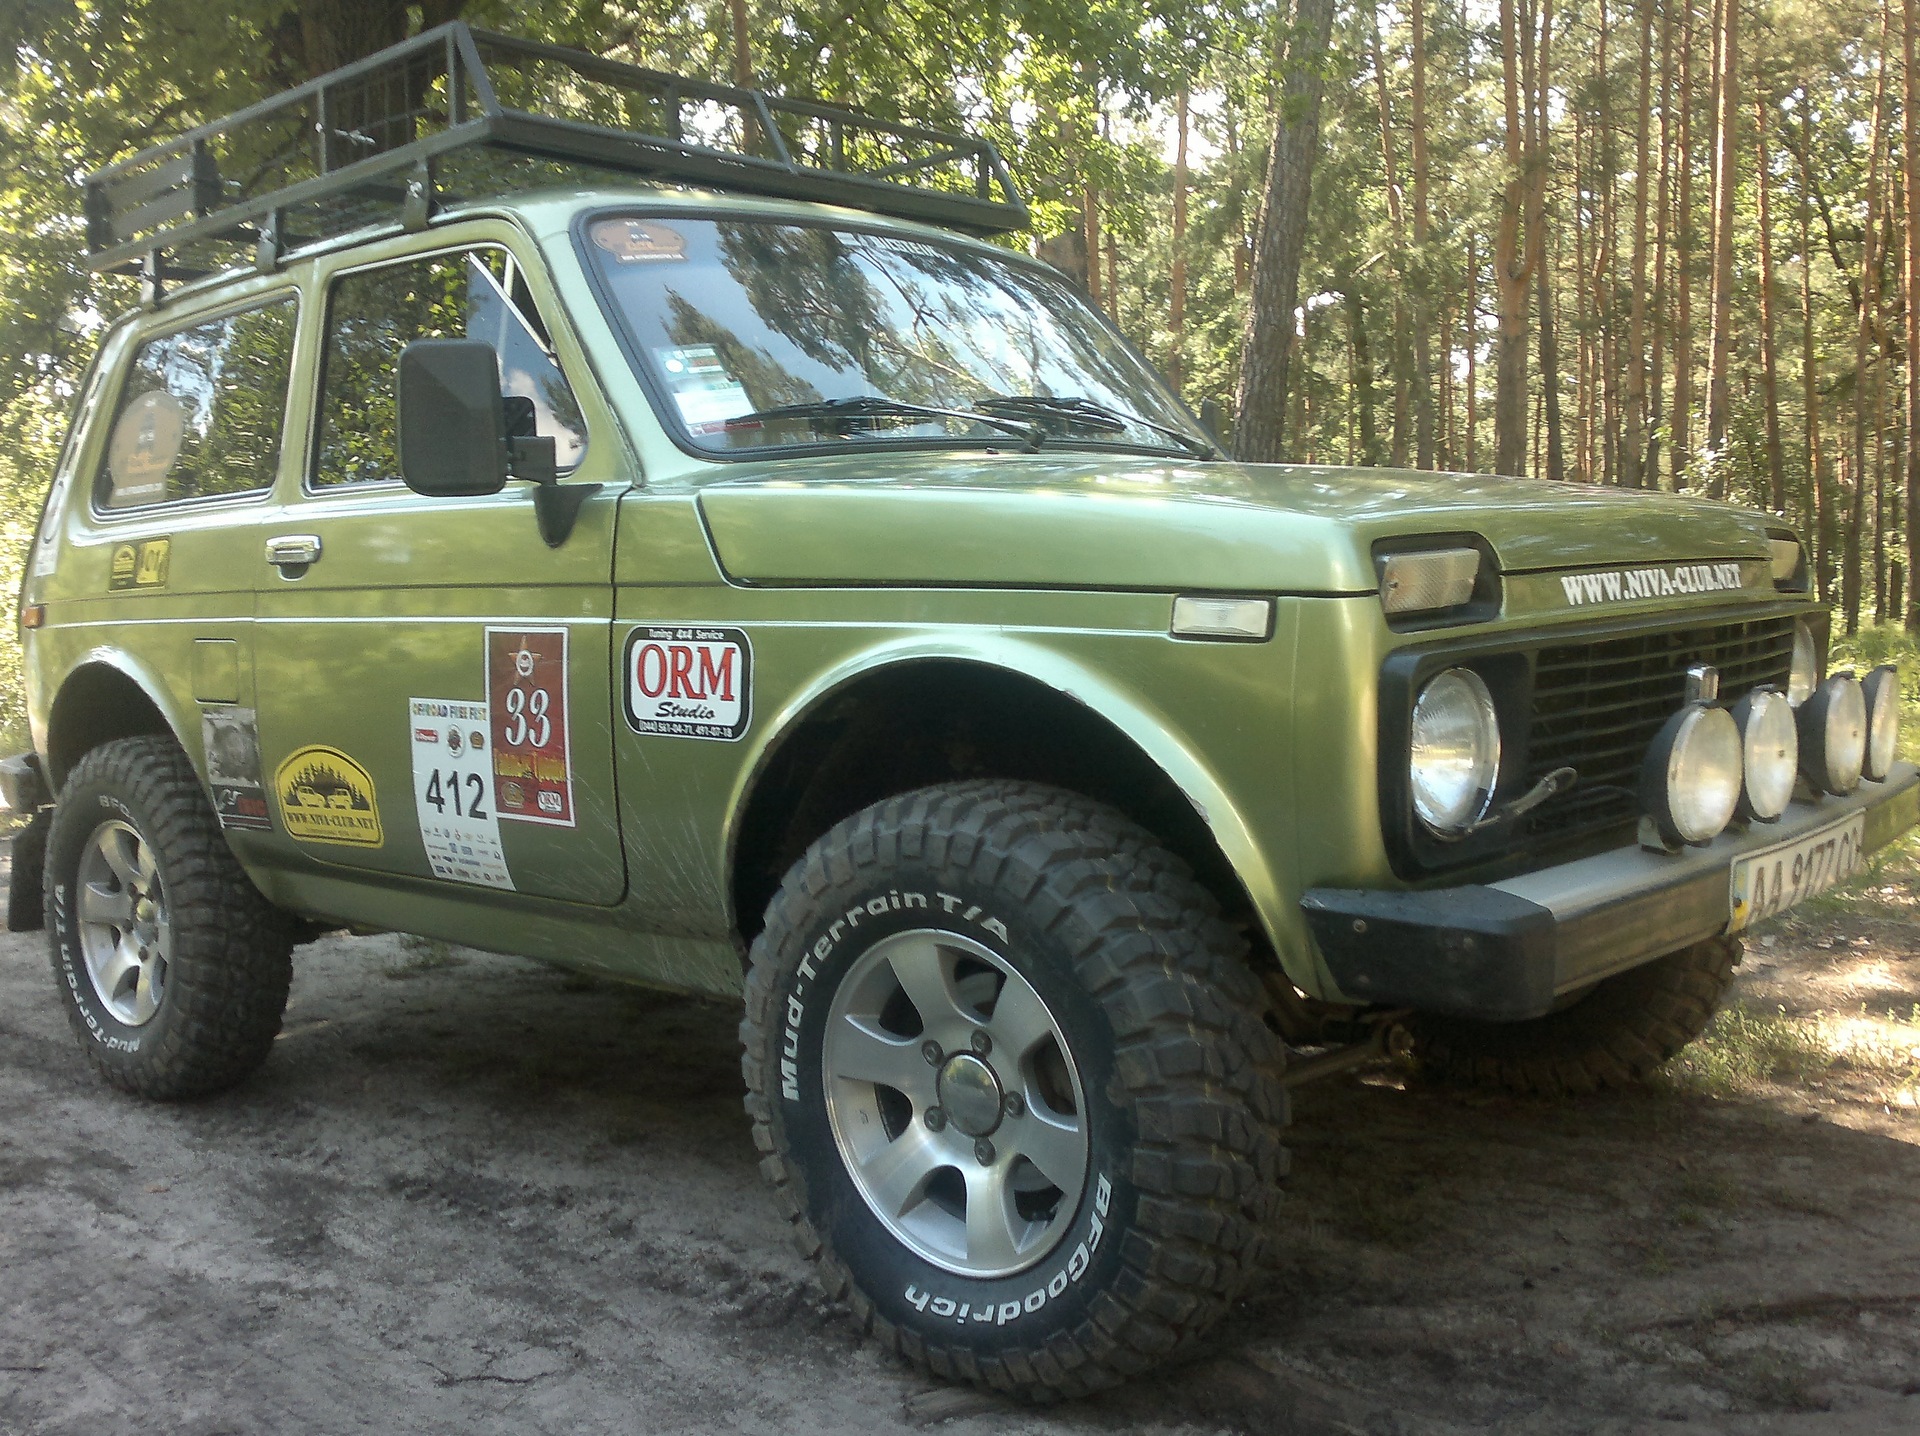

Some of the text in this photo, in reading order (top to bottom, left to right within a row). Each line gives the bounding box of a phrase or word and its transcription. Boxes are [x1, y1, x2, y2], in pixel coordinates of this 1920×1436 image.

[1561, 563, 1742, 606] WWW.NIVA-CLUB.NET
[649, 628, 725, 640] Tuning 4x4 Service
[637, 643, 736, 702] ORM
[505, 688, 551, 748] 33
[655, 701, 716, 720] Studio
[426, 768, 488, 820] 412
[780, 889, 928, 1101] Mud-Terrain
[903, 1171, 1113, 1327] BFGoodrich
